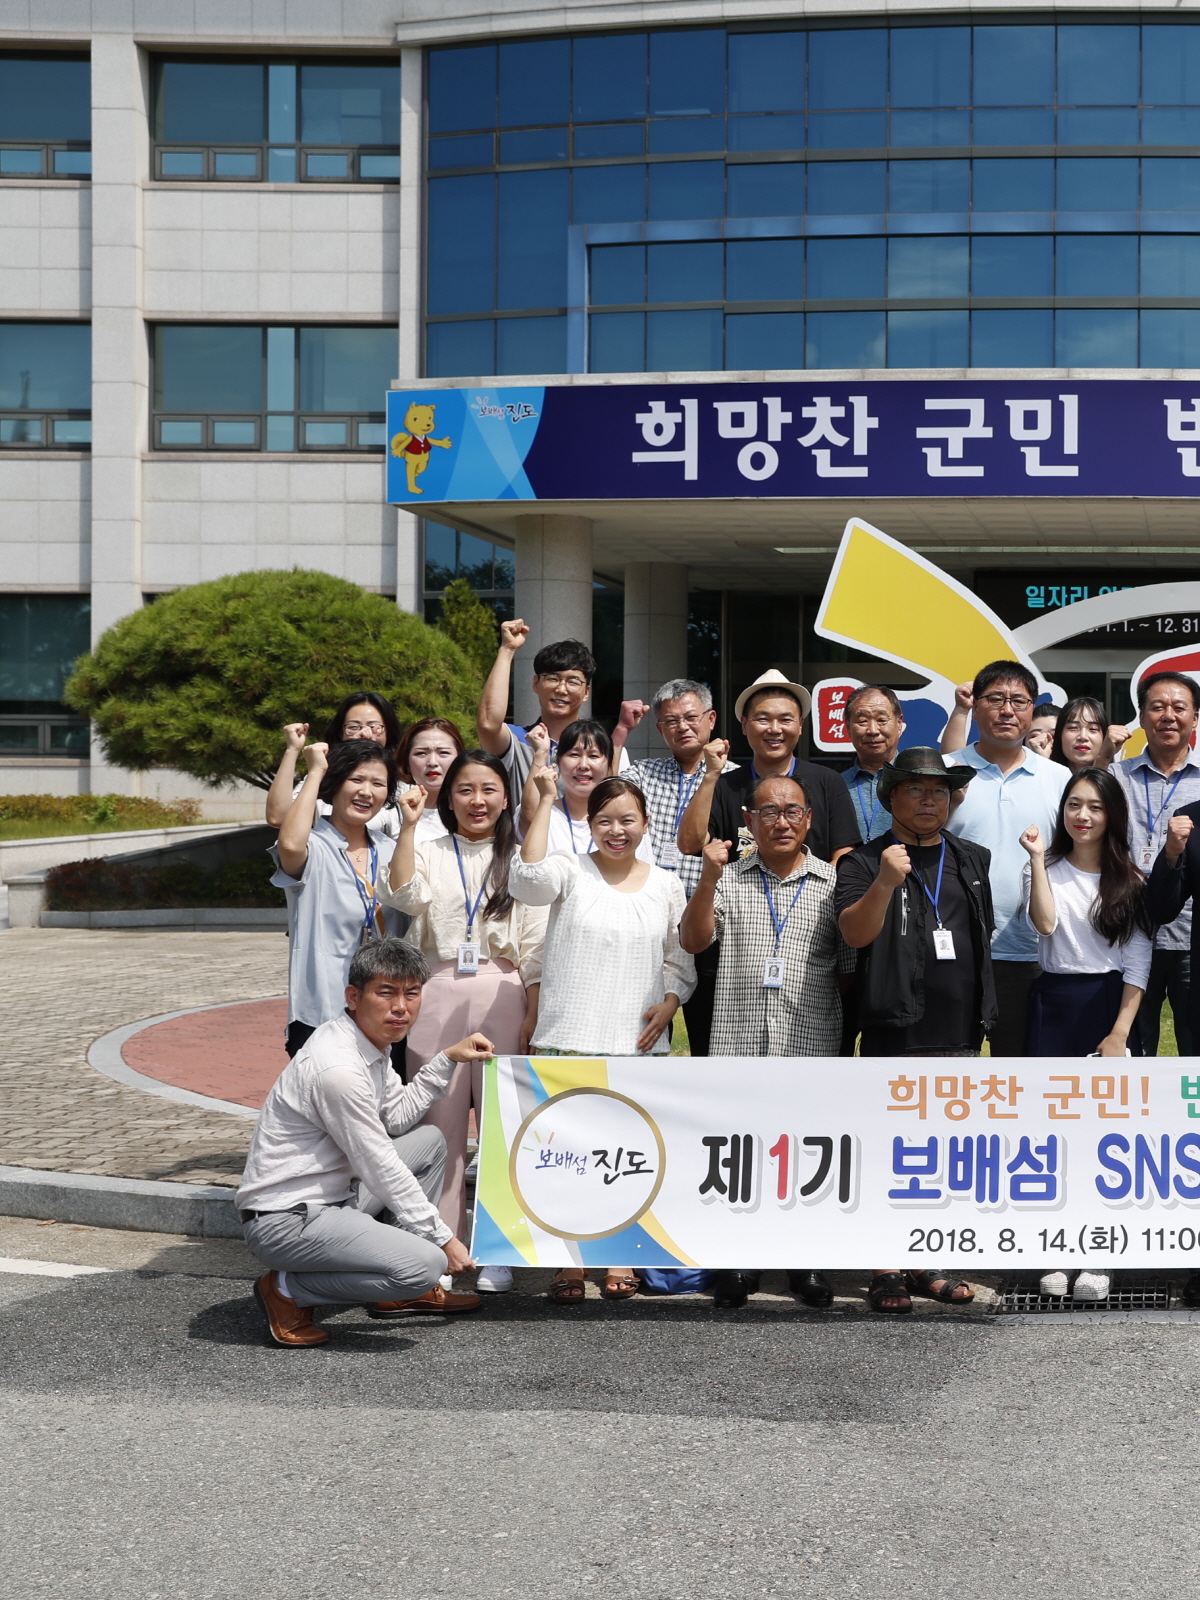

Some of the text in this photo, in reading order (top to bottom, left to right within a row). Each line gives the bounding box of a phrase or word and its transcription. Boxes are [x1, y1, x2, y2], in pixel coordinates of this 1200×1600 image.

[506, 403, 537, 423] 진도
[632, 395, 879, 481] 희망찬
[916, 395, 1079, 478] 군민
[1025, 585, 1089, 608] 일자리
[828, 691, 846, 738] 보배섬
[888, 1075, 1024, 1121] 희망찬
[1044, 1076, 1150, 1121] 군민!
[535, 1147, 654, 1185] 보배섬 진도
[699, 1134, 852, 1204] 제1기
[888, 1134, 1058, 1202] 보배섬
[909, 1228, 985, 1254] 2018.
[998, 1228, 1024, 1254] 8.
[1039, 1225, 1129, 1256] 14.(화)
